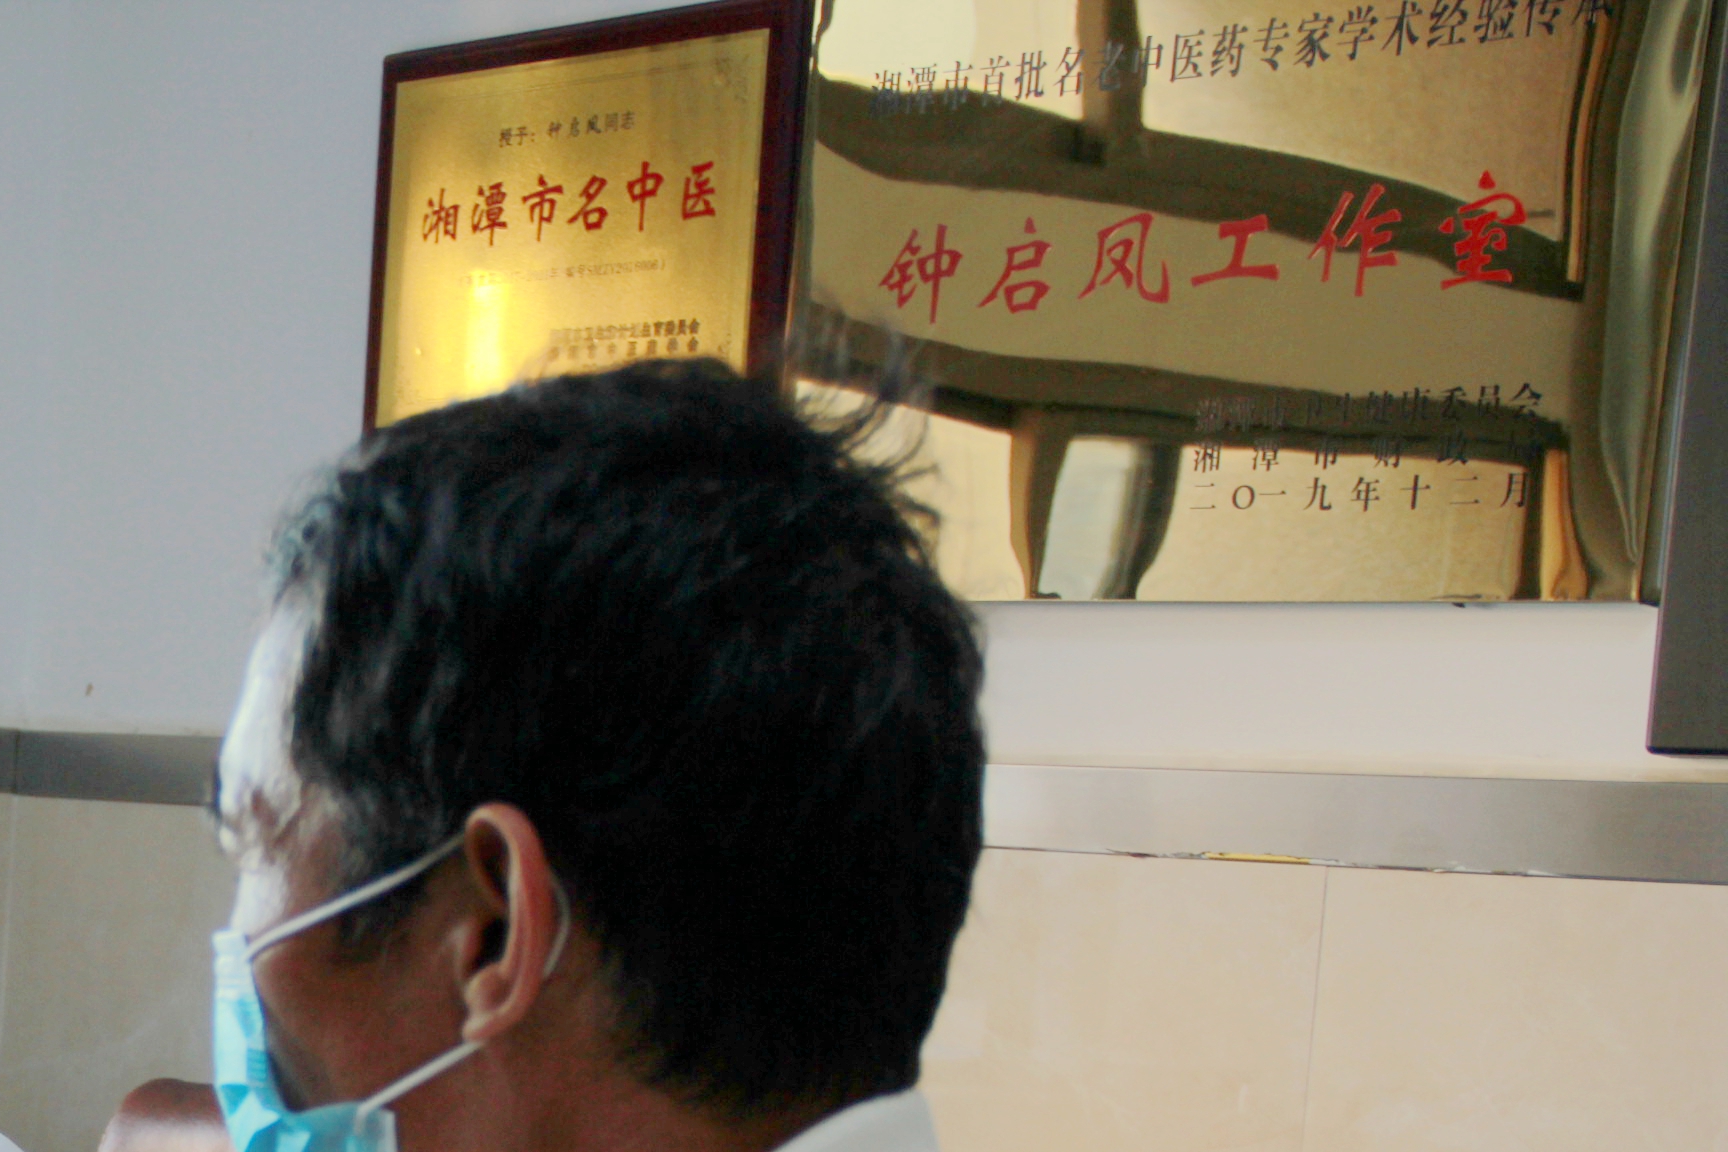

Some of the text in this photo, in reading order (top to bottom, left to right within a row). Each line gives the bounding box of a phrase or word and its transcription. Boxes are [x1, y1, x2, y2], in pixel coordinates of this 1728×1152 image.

[422, 160, 717, 247] 湘潭市名中医
[877, 169, 1531, 324] 钟启凤工作室
[1193, 430, 1537, 473] 湘潭市财政
